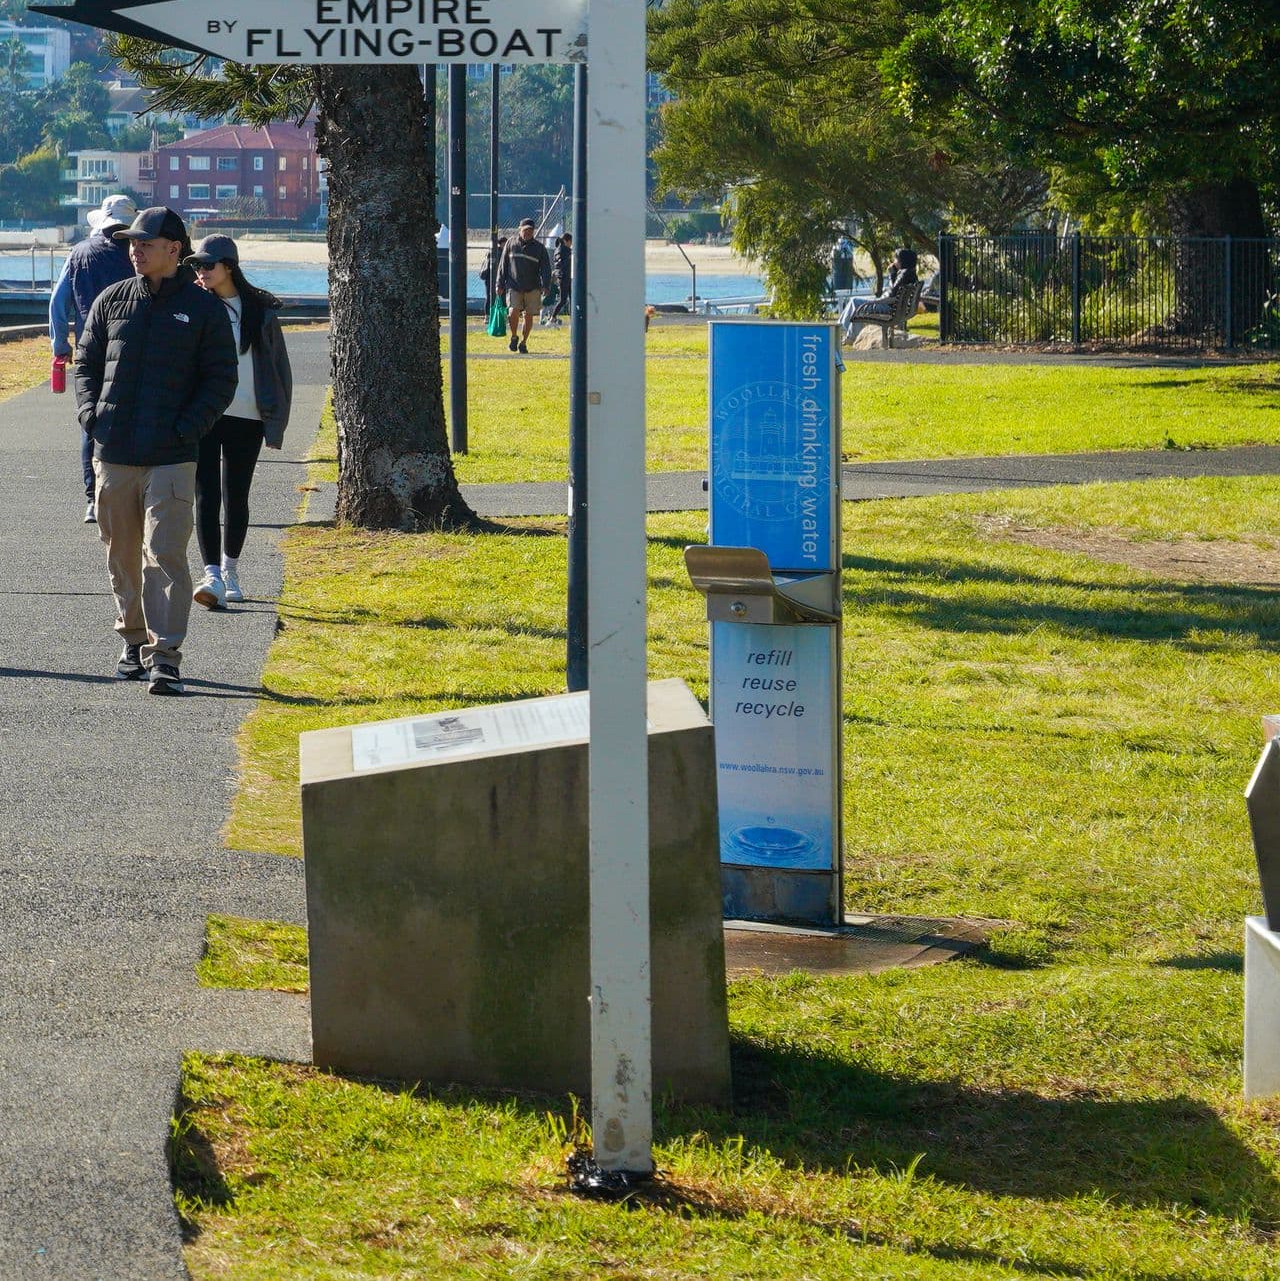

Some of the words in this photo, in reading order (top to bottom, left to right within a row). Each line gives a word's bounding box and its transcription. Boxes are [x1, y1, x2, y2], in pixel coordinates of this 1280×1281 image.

[207, 20, 238, 34] BY
[246, 28, 562, 58] FLYING-BOAT
[801, 334, 822, 391] fresh
[800, 398, 822, 489] drinking
[801, 498, 821, 562] water
[747, 649, 792, 667] refill
[742, 675, 797, 693] reuse
[735, 700, 806, 720] recycle
[719, 761, 824, 777] www.woollahra.nsw.gov.au
